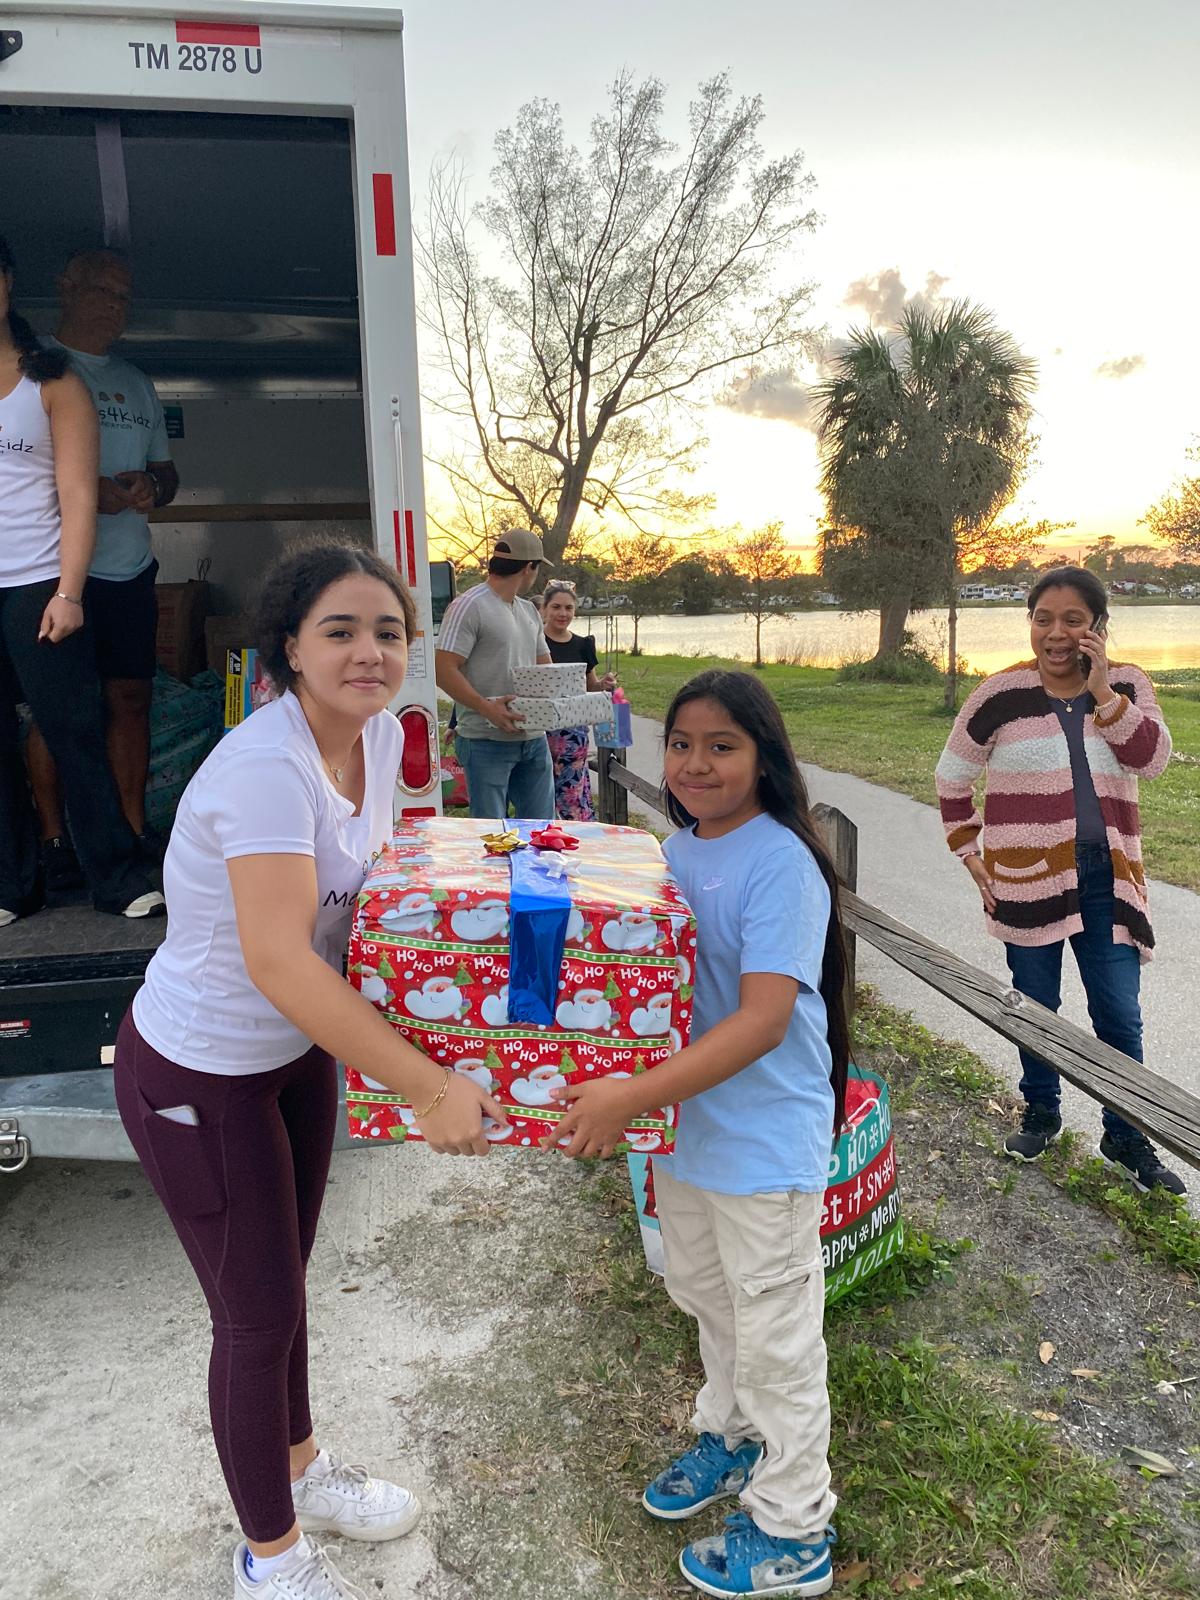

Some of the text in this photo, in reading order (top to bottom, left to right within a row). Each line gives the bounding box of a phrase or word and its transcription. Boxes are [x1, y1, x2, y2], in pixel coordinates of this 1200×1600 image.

[128, 42, 262, 74] TM 2878 U
[396, 949, 417, 962] HO
[413, 961, 433, 973] HO
[434, 955, 454, 967] HO
[474, 956, 494, 969] HO
[490, 965, 509, 978] HO
[565, 969, 583, 984] HO
[584, 966, 604, 978] HO
[621, 967, 641, 979] HO
[637, 976, 657, 989] HO
[657, 970, 676, 982] HO
[396, 1026, 669, 1068] O HO HO HO HO HO HO HO HO HO HO
[847, 1131, 867, 1176] HO
[848, 1176, 864, 1215] it
